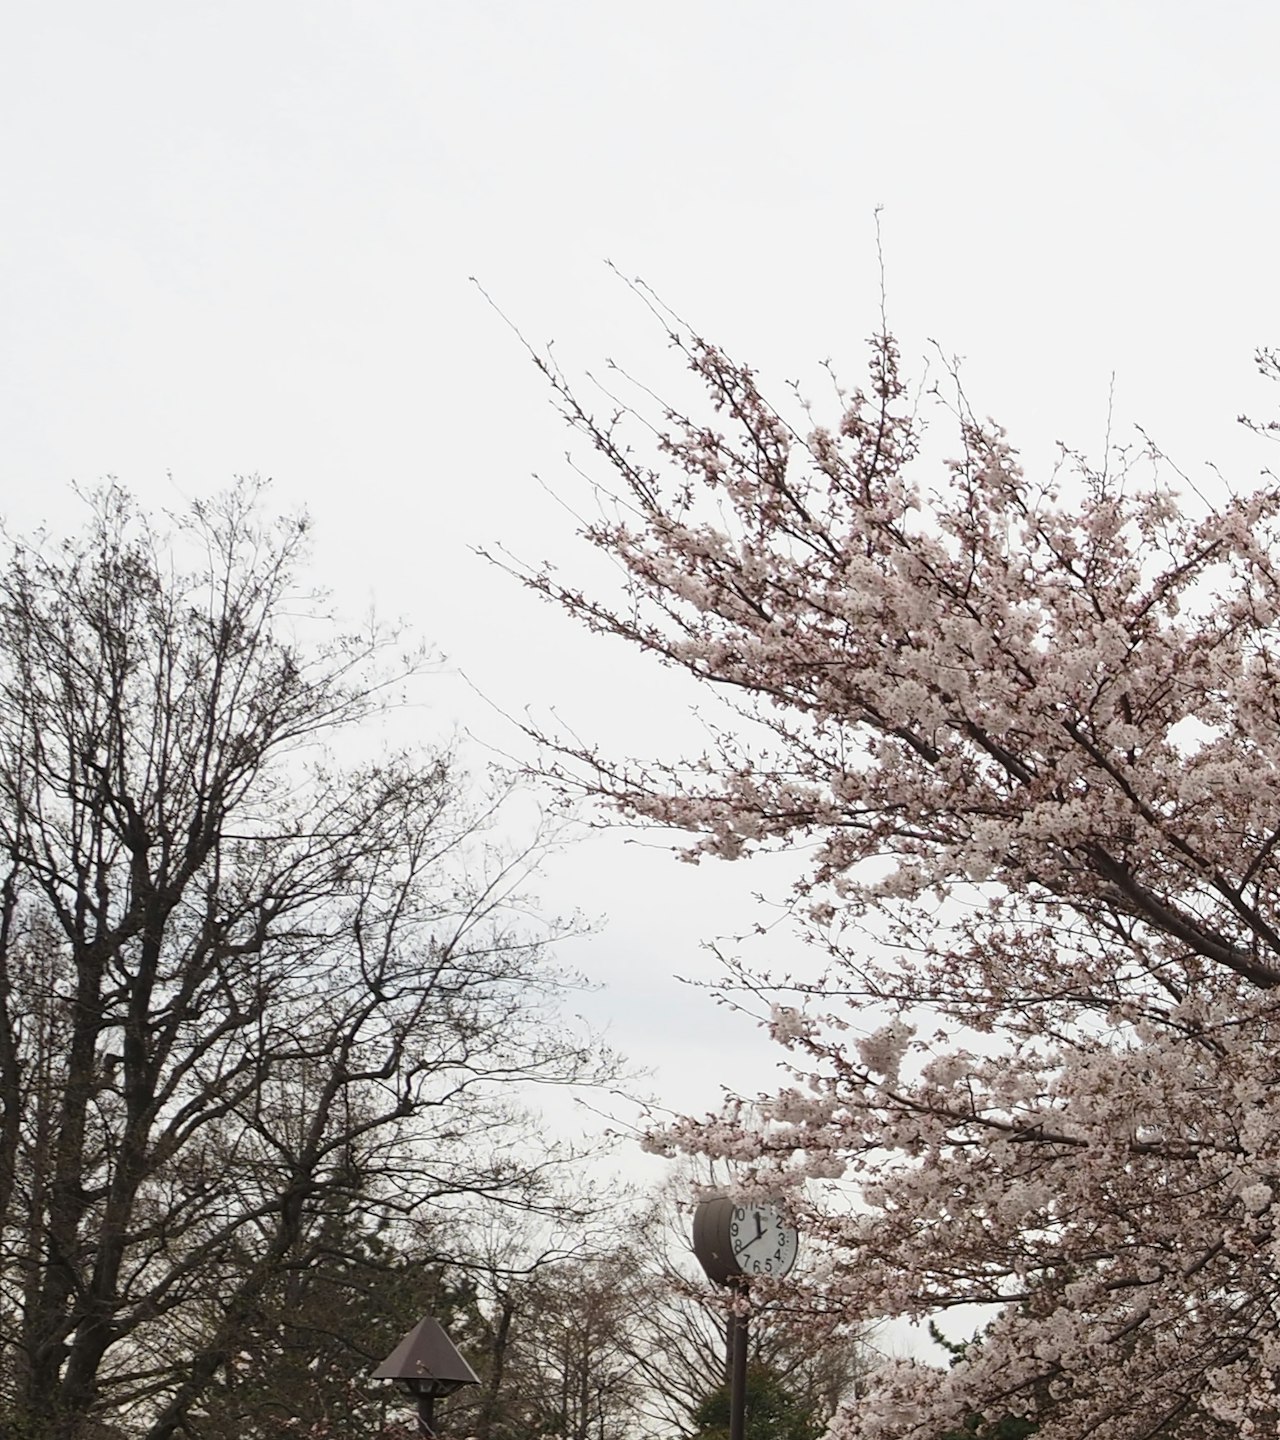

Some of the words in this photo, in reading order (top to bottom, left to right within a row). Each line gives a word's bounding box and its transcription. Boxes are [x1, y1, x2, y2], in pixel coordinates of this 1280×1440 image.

[776, 1215, 783, 1229] 2
[731, 1223, 738, 1236] 9
[778, 1233, 785, 1246] 3
[734, 1240, 742, 1253] 8
[743, 1254, 750, 1267] 7
[773, 1249, 781, 1262] 4
[753, 1260, 761, 1273] 6
[764, 1258, 772, 1272] 5
